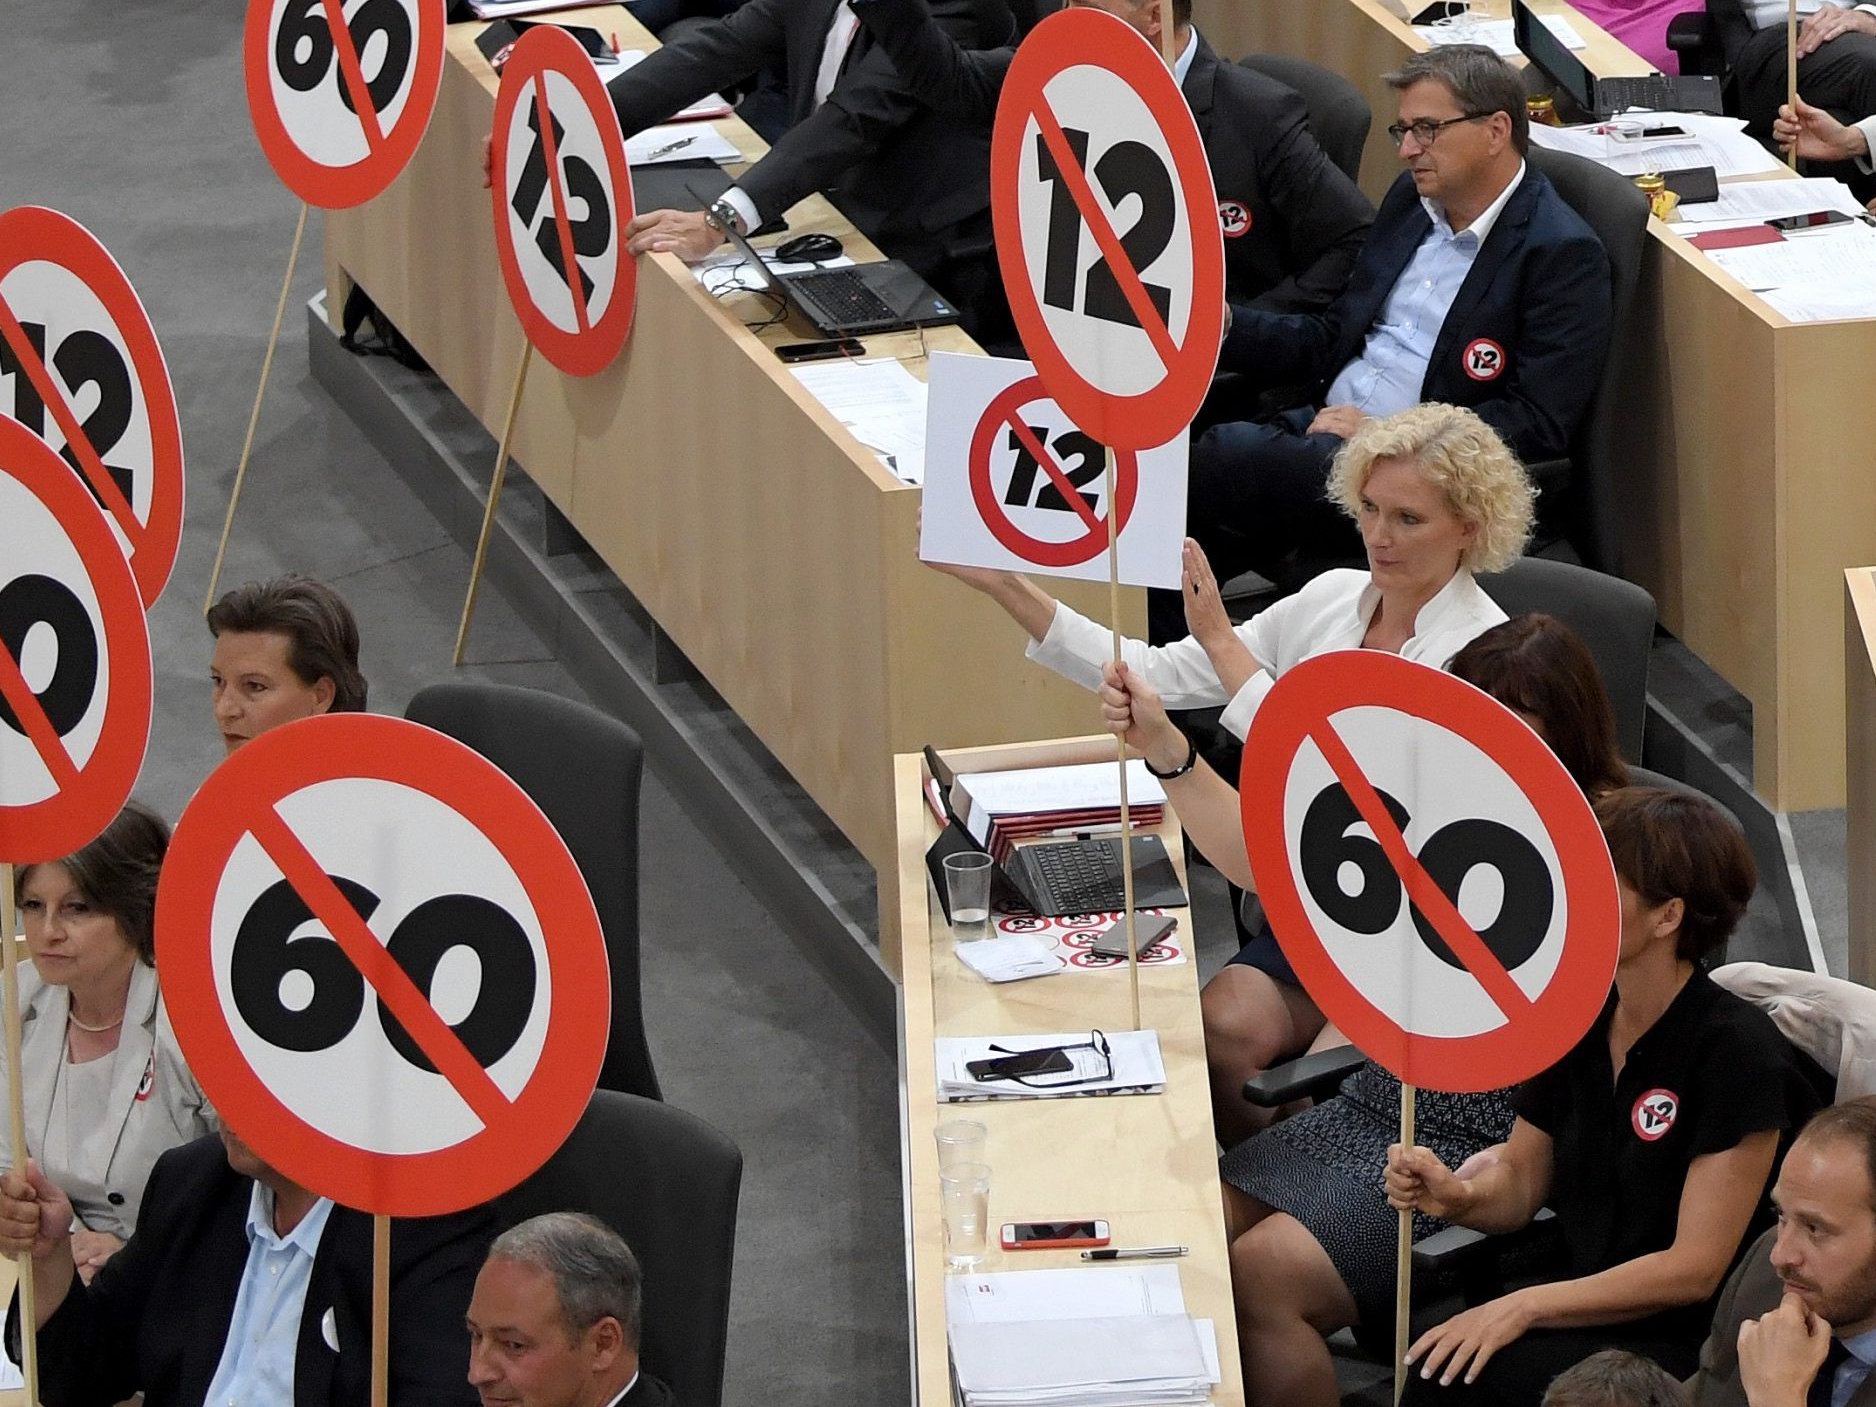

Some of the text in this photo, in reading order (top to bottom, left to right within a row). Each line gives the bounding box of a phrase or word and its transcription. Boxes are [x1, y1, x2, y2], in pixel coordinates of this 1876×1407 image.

[512, 92, 615, 302] 12
[1037, 128, 1175, 328] 12
[1219, 206, 1247, 229] 12
[0, 322, 133, 510] 12
[1472, 350, 1498, 369] 12
[1004, 427, 1106, 512] 12
[1300, 782, 1553, 972] 60
[231, 875, 536, 1074] 60
[1642, 1101, 1674, 1129] 12
